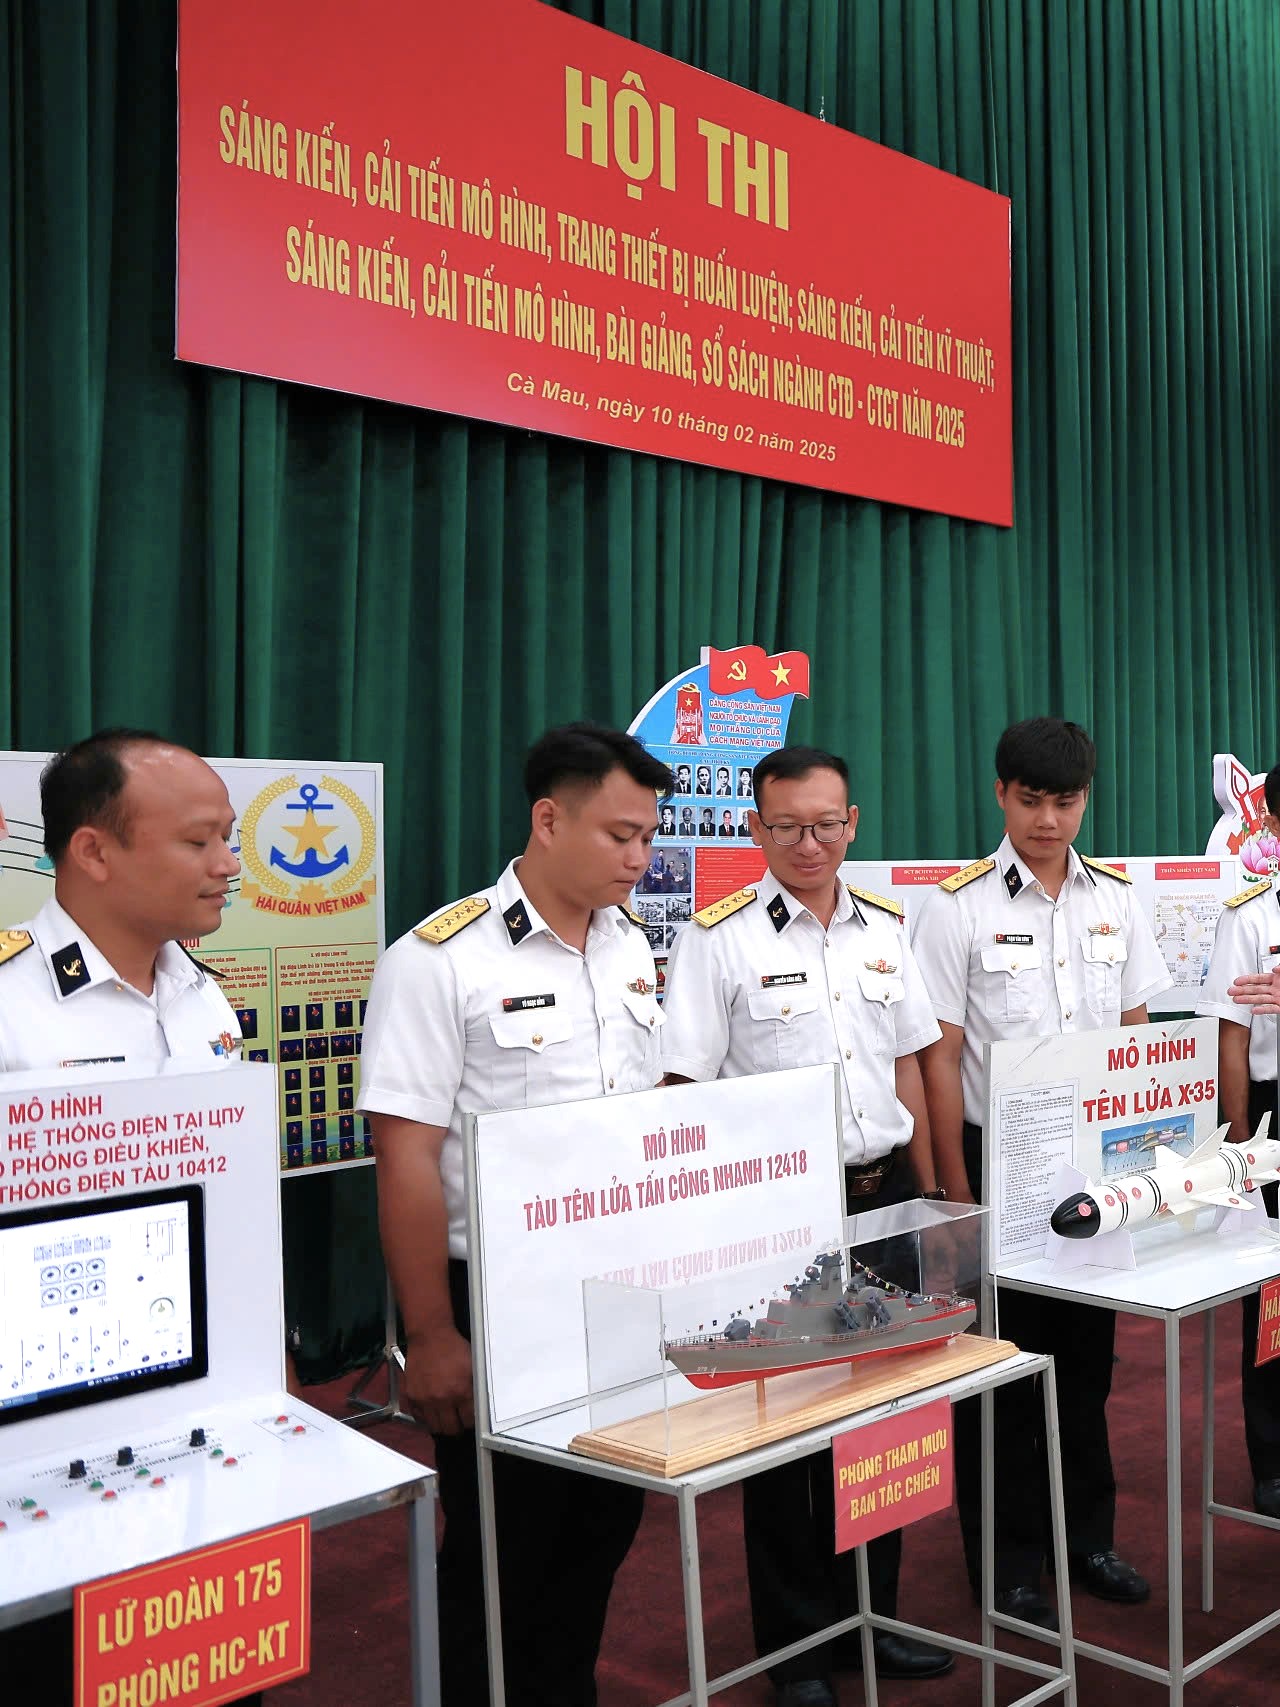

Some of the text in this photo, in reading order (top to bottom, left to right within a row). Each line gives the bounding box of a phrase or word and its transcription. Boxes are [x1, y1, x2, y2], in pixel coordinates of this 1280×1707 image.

[566, 66, 789, 232] HỘI THI
[219, 99, 995, 394] SÁNG KIẾN, CẢI TIẾN MÔ HÌNH, TRANG THIẾT BỊ HUẤN LUYỆN; SÁNG KIẾN, CẢI TIẾN KỸ THUẬT;
[285, 218, 351, 296] SÁNG
[357, 235, 416, 319] KIẾN,
[422, 249, 458, 322] CẢI
[463, 263, 509, 335] TIẾN
[514, 282, 545, 343] MÔ
[551, 289, 601, 364] HÌNH,
[606, 305, 636, 366] BÀI
[640, 311, 697, 387] GIẢNG,
[701, 324, 724, 388] SỔ
[727, 339, 769, 399] SÁCH
[773, 354, 824, 413] NGÀNH
[827, 372, 854, 420] CTĐ
[867, 383, 899, 431] CTCT
[902, 387, 932, 440] NĂM
[935, 402, 965, 449] 2025
[507, 372, 836, 462] Cà Mau, ngày 10 tháng 02 năm 2025
[256, 892, 366, 915] HẢI QUÂN VIỆT NAM
[1108, 1032, 1196, 1071] MÔ HÌNH
[8, 1093, 102, 1125] MÔ HÌNH
[1083, 1078, 1215, 1122] TÊN LỬA X-35
[8, 1130, 36, 1153] HỆ
[43, 1122, 116, 1147] THỐNG
[122, 1114, 167, 1138] ĐIỆN
[173, 1112, 203, 1133] TẠI
[94, 1141, 140, 1166] ĐIỀU
[643, 1122, 706, 1162] MÔ HÌNH
[78, 1170, 125, 1193] ĐIỆN
[131, 1161, 170, 1185] TÀU
[177, 1156, 227, 1178] 10412
[524, 1149, 808, 1232] TÀU TÊN LỬA TẤN CÔNG NHANH 12418
[839, 1429, 947, 1489] PHÒNG THAM MƯU
[851, 1461, 940, 1520] BAN TÁC CHIẾN
[98, 1558, 282, 1654] LỮ ĐOÀN 175
[98, 1620, 290, 1707] PHÒNG HC-KT
